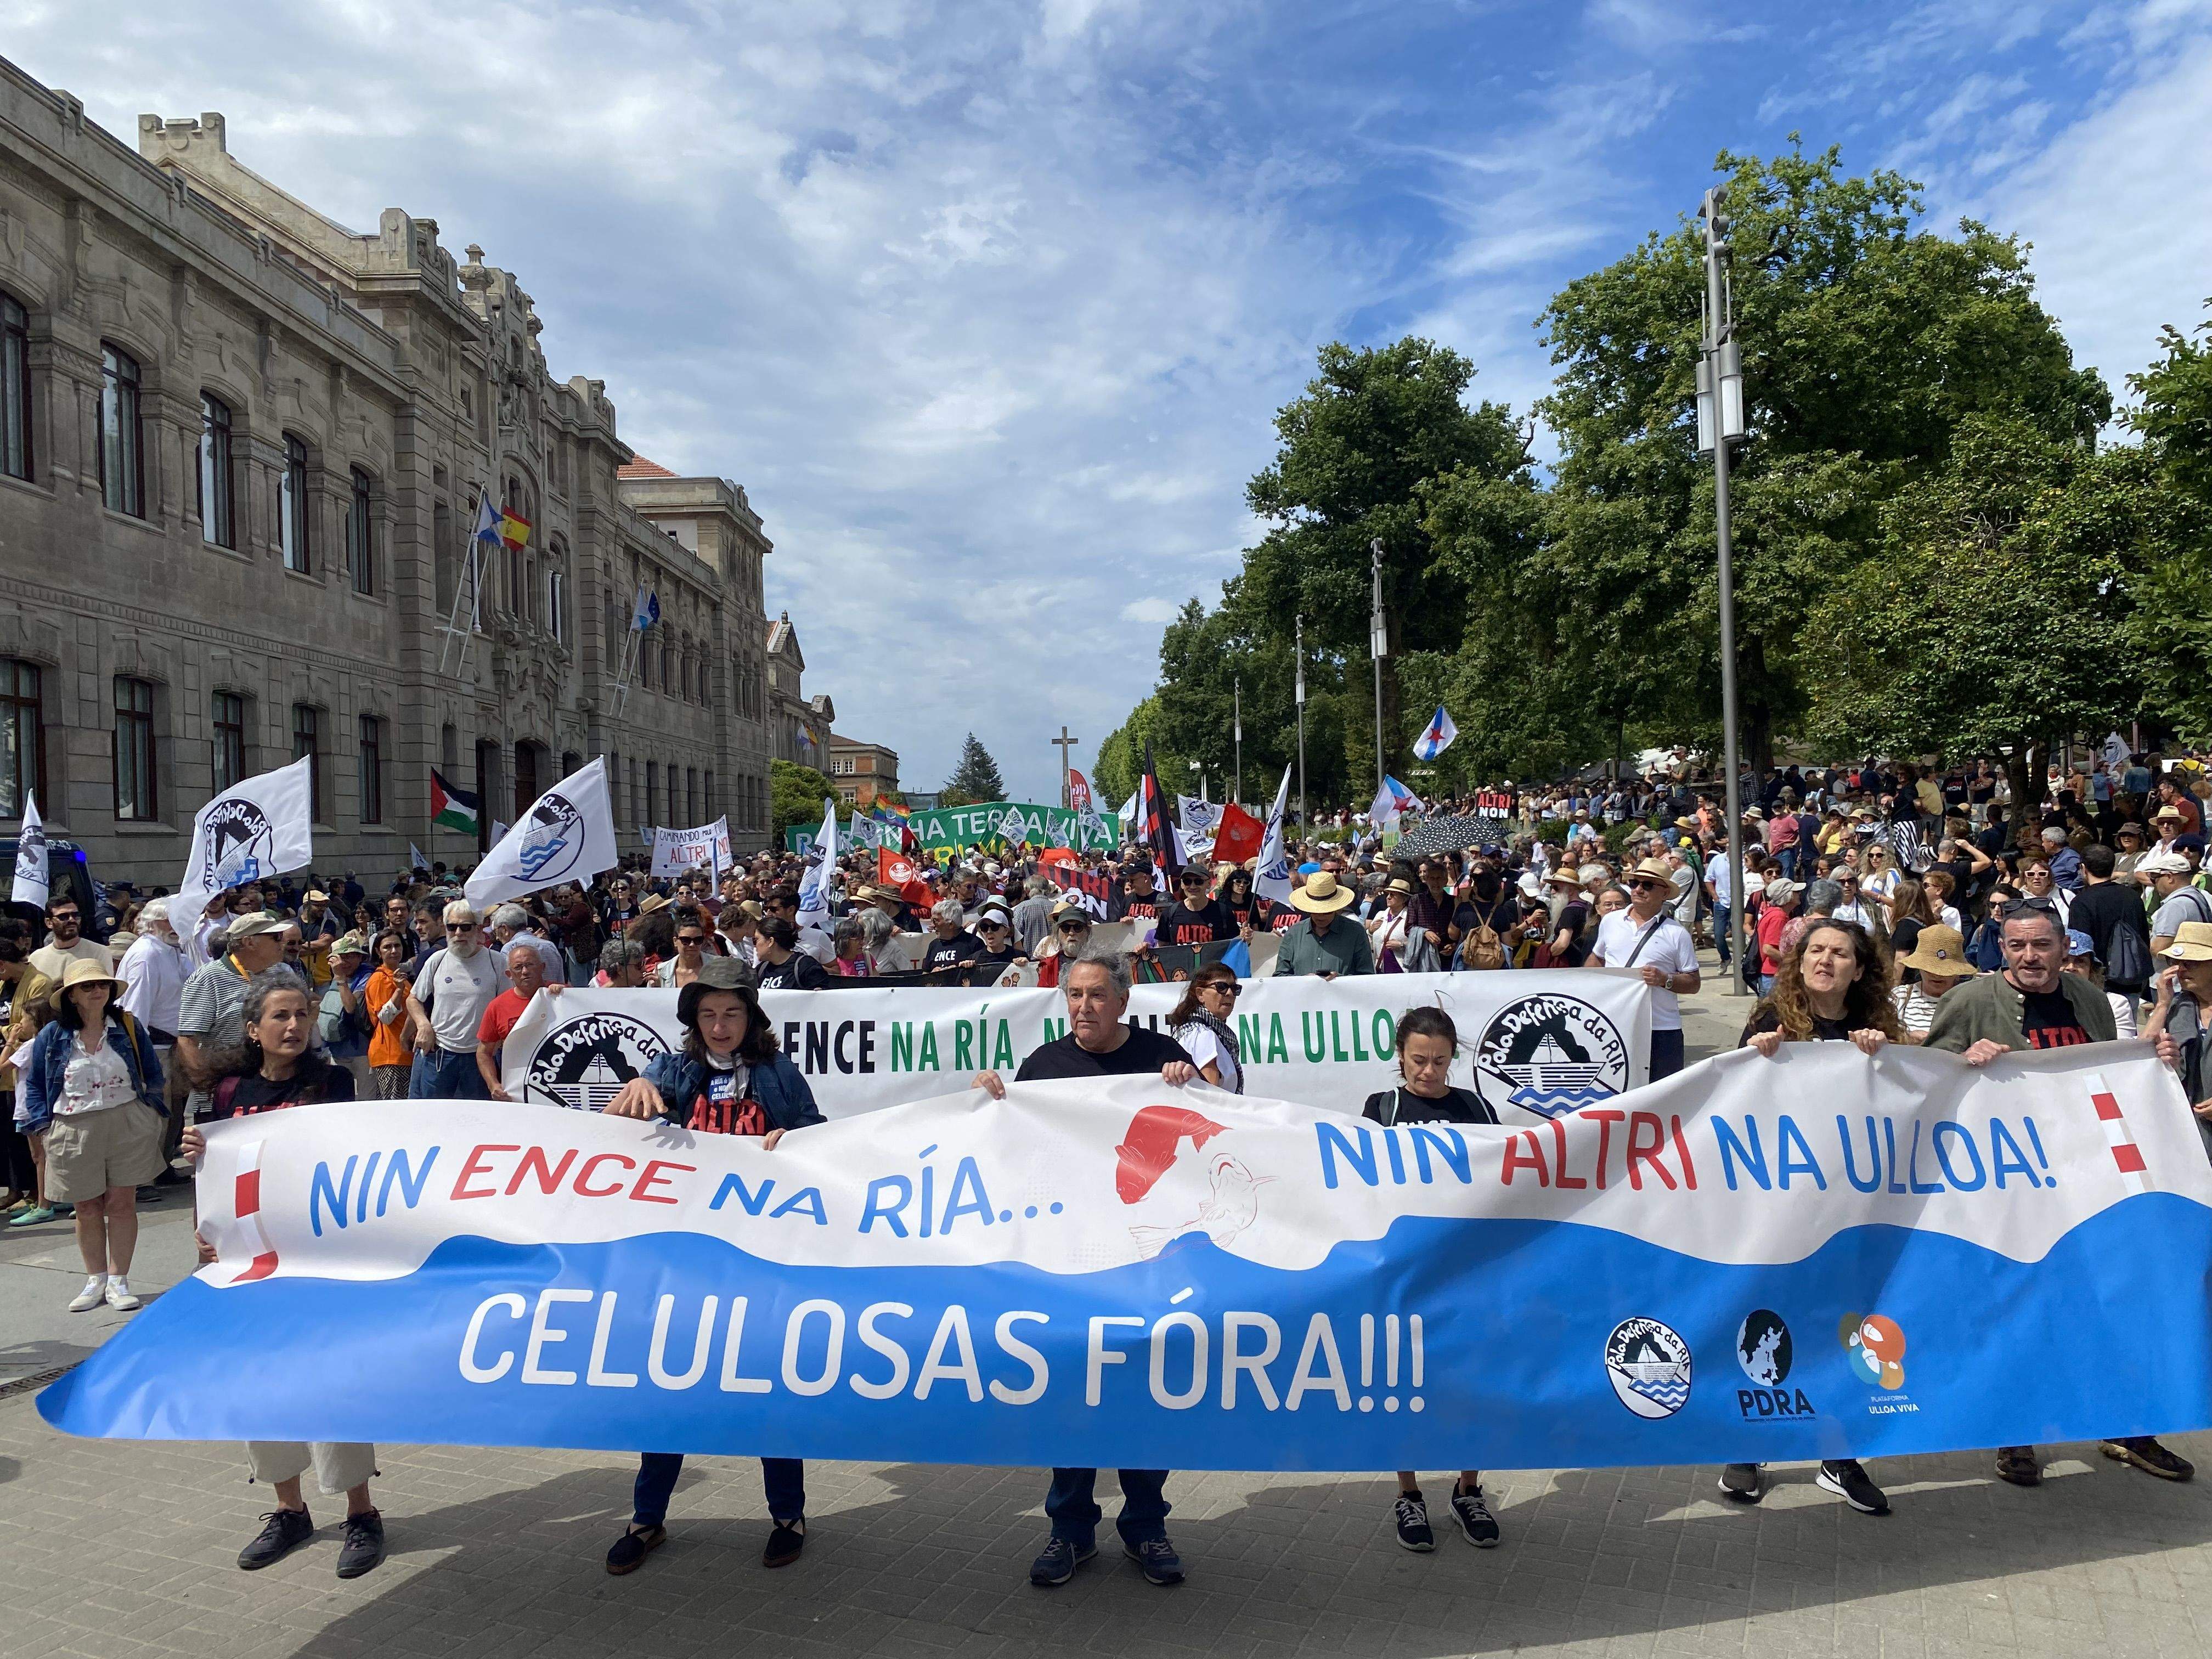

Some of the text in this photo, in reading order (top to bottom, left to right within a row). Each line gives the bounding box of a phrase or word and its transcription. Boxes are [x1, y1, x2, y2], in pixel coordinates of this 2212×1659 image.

[1477, 793, 1511, 808] ALTRI
[1479, 807, 1509, 819] NON
[796, 831, 855, 854] PR
[884, 817, 946, 847] NHA
[951, 809, 1043, 836] TERA
[670, 844, 706, 863] ALTRI
[1038, 862, 1109, 901] ALTRI
[1177, 924, 1213, 943] ALTRI
[1273, 914, 1302, 928] ALTRI
[934, 950, 956, 962] ENCE
[760, 975, 783, 989] ECE
[529, 1052, 565, 1092] Pola
[555, 1019, 637, 1053] Defensa
[784, 1020, 876, 1075] ENCE
[891, 1021, 940, 1072] NA
[1238, 1008, 1414, 1064] NA ULLO
[1477, 1000, 1625, 1075] Pola Defensa da RIA
[686, 1094, 765, 1135] ALTRI
[1314, 1110, 2058, 1194] NIN ALTRI NA ULLOA!
[310, 1144, 1064, 1238] NIN ENCE NA RÍA...
[459, 1287, 1425, 1413] CELULOSAS FÓRA!!!
[1607, 1322, 1691, 1372] Pola Defensa da RIA
[1737, 1389, 1816, 1417] PDRA
[1869, 1403, 1920, 1414] ULLOA VIVA
